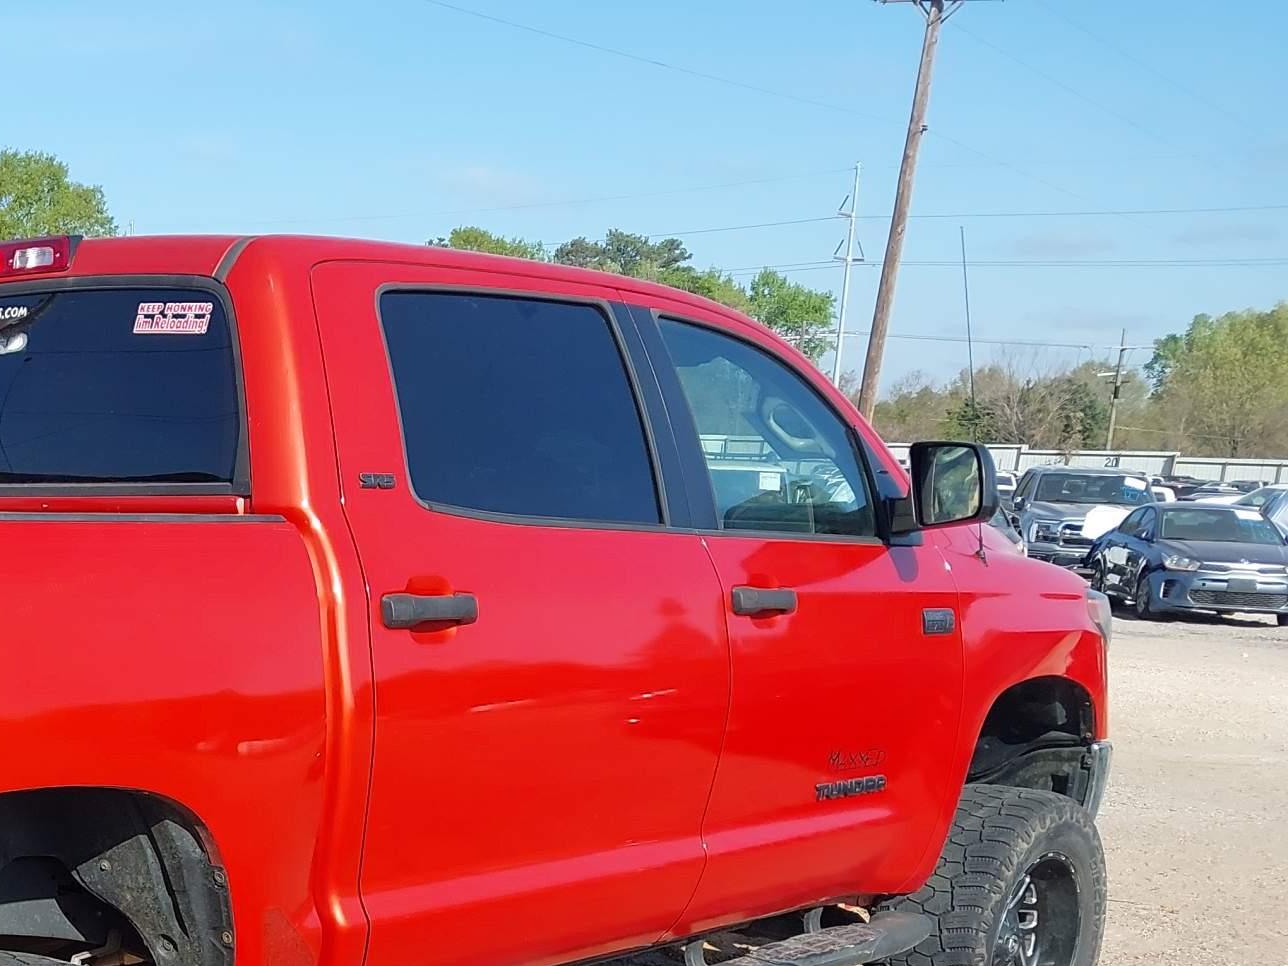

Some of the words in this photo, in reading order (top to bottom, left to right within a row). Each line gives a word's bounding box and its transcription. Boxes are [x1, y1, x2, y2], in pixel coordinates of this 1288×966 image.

[139, 303, 164, 313] KEEP
[165, 303, 213, 313] HONKING
[153, 314, 210, 333] Reloading!
[359, 472, 396, 489] SR5
[815, 775, 886, 802] TUNDRA
